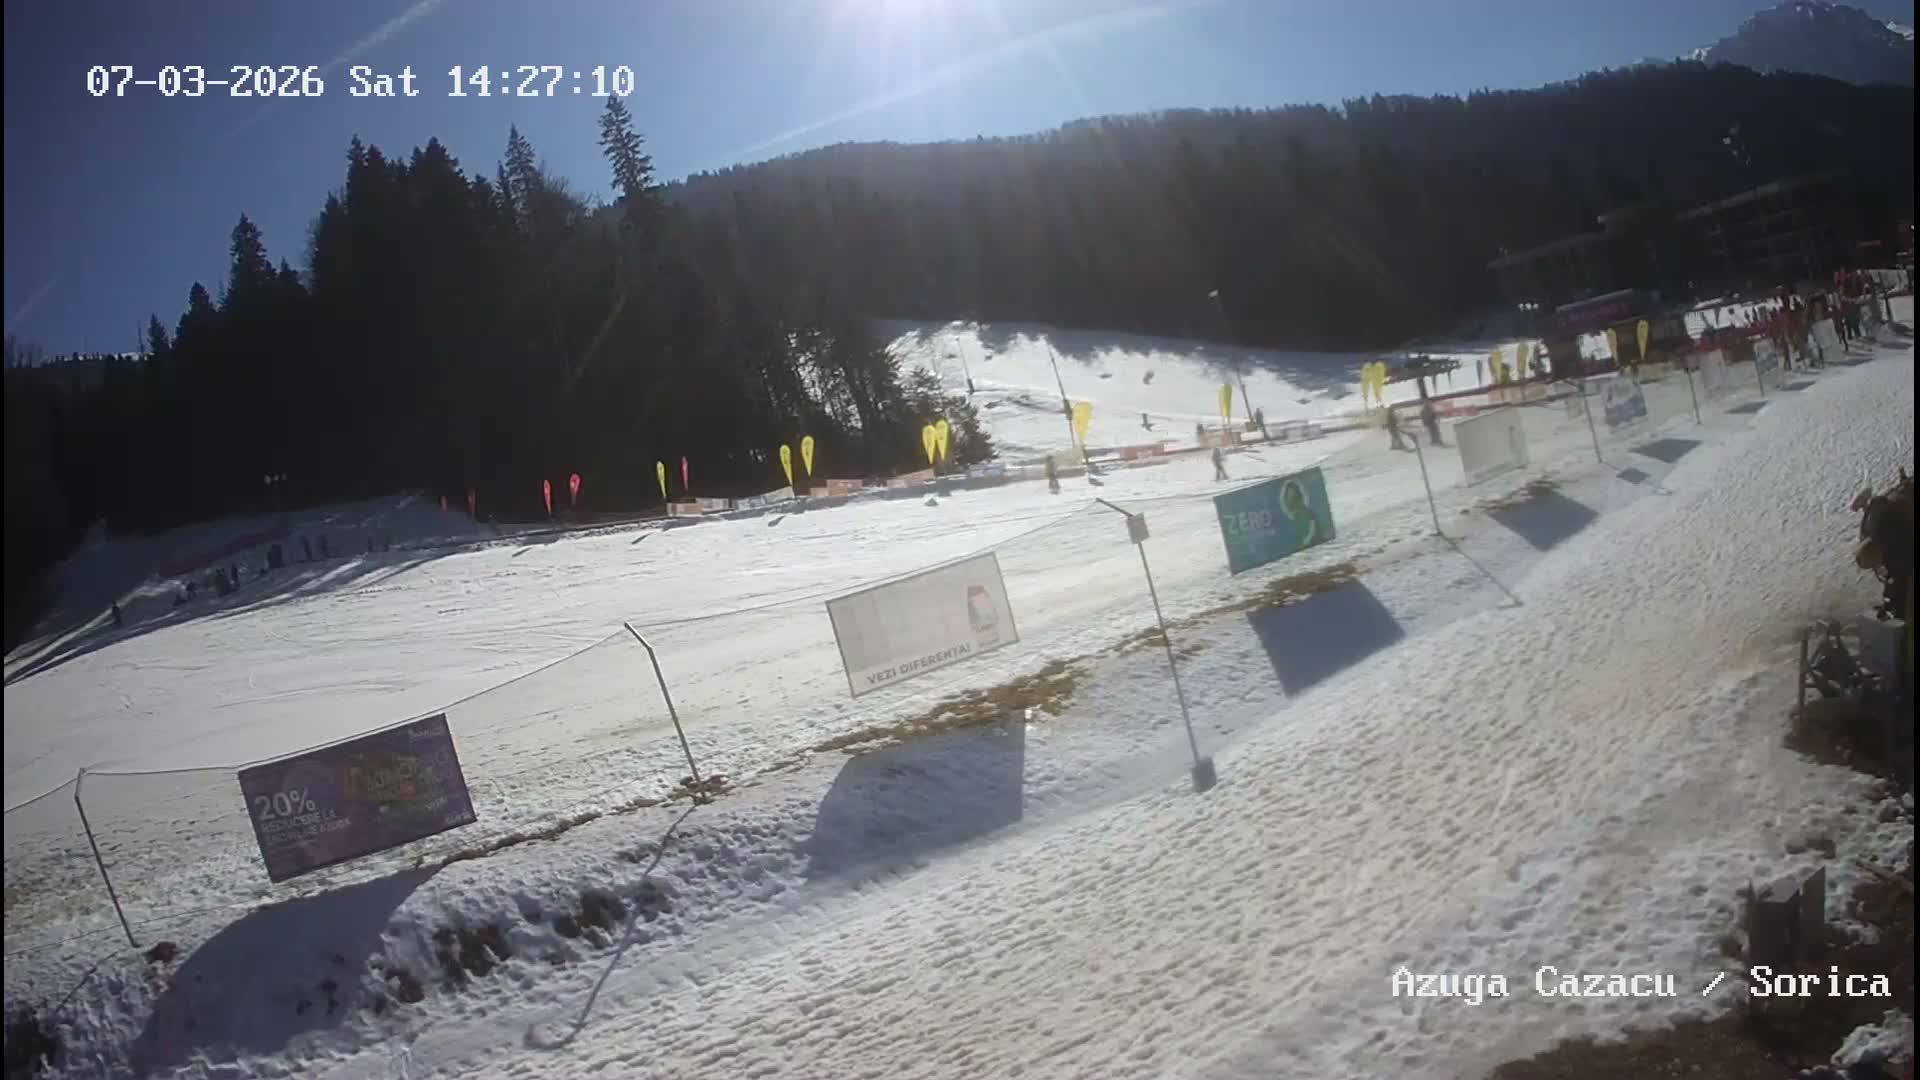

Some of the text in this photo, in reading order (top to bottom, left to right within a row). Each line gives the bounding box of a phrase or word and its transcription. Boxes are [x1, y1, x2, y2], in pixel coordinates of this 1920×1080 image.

[1224, 510, 1273, 535] ZERO
[867, 669, 897, 684] VEZI
[254, 786, 316, 821] 20%
